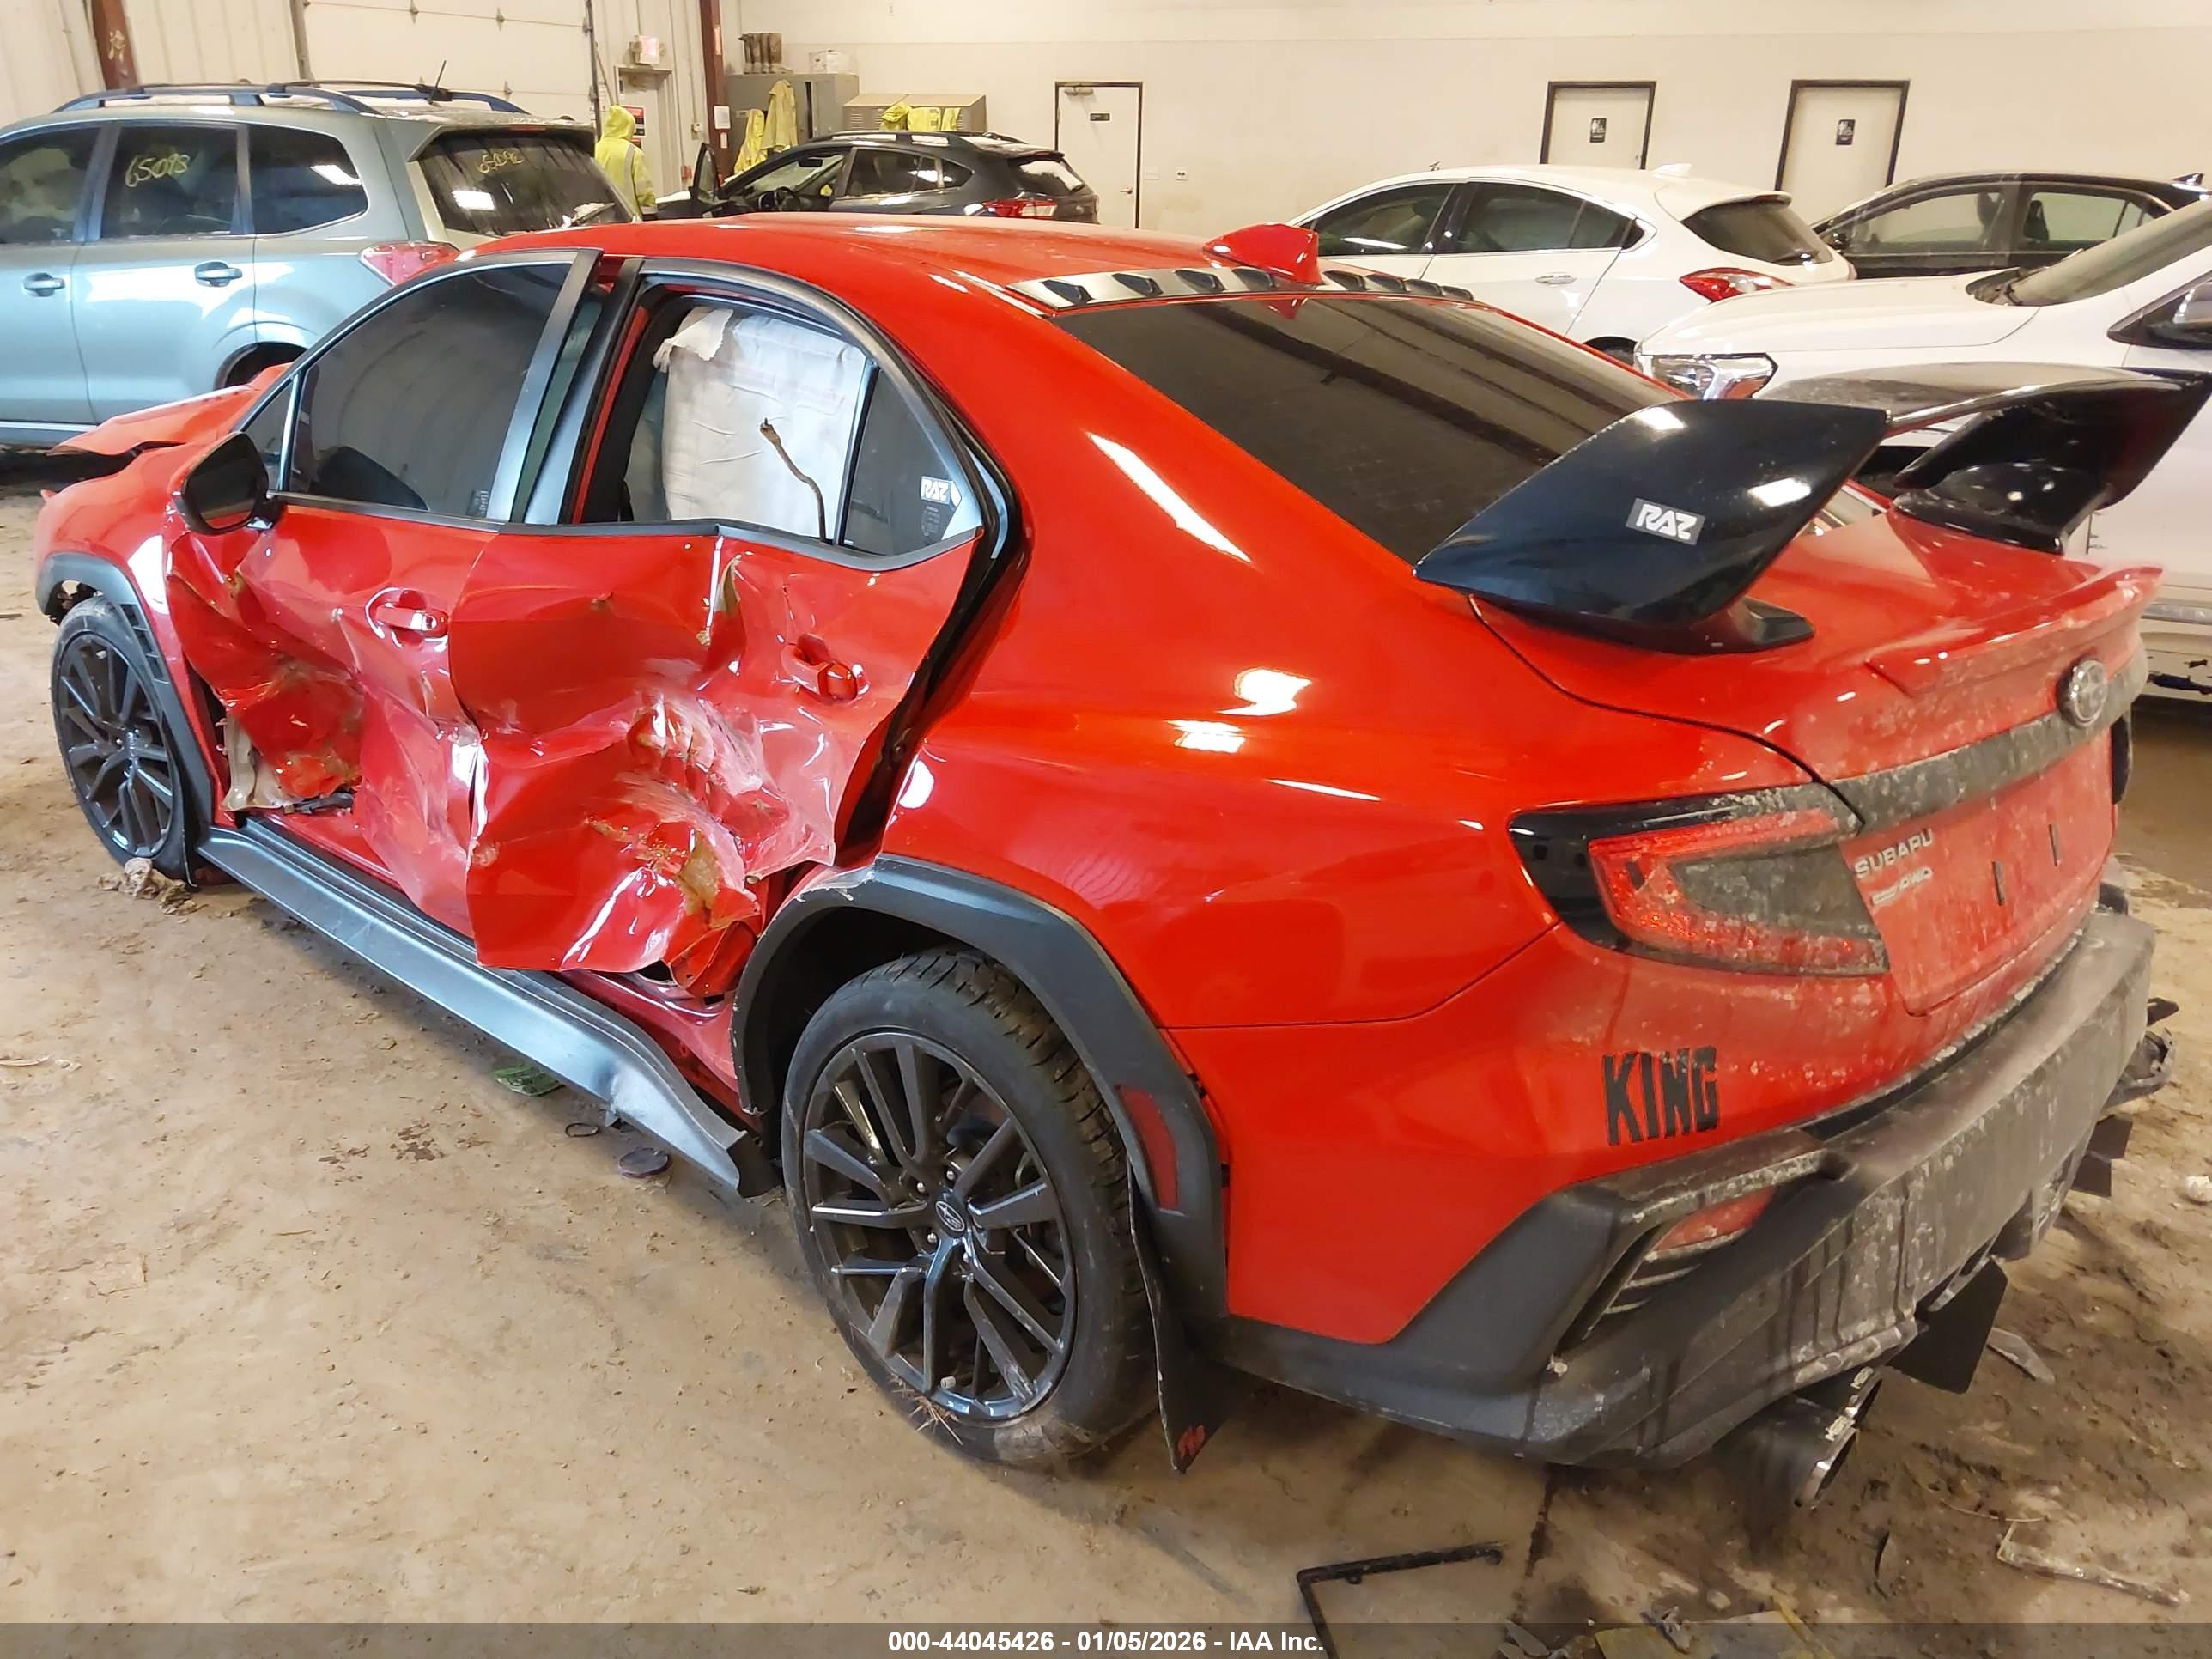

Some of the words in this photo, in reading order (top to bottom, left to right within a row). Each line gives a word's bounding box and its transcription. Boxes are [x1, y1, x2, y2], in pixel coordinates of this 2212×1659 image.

[921, 477, 949, 502] RAZ
[1635, 503, 1698, 541] RAZ
[1854, 828, 1934, 880] SUBARU
[1602, 1044, 1720, 1146] KING
